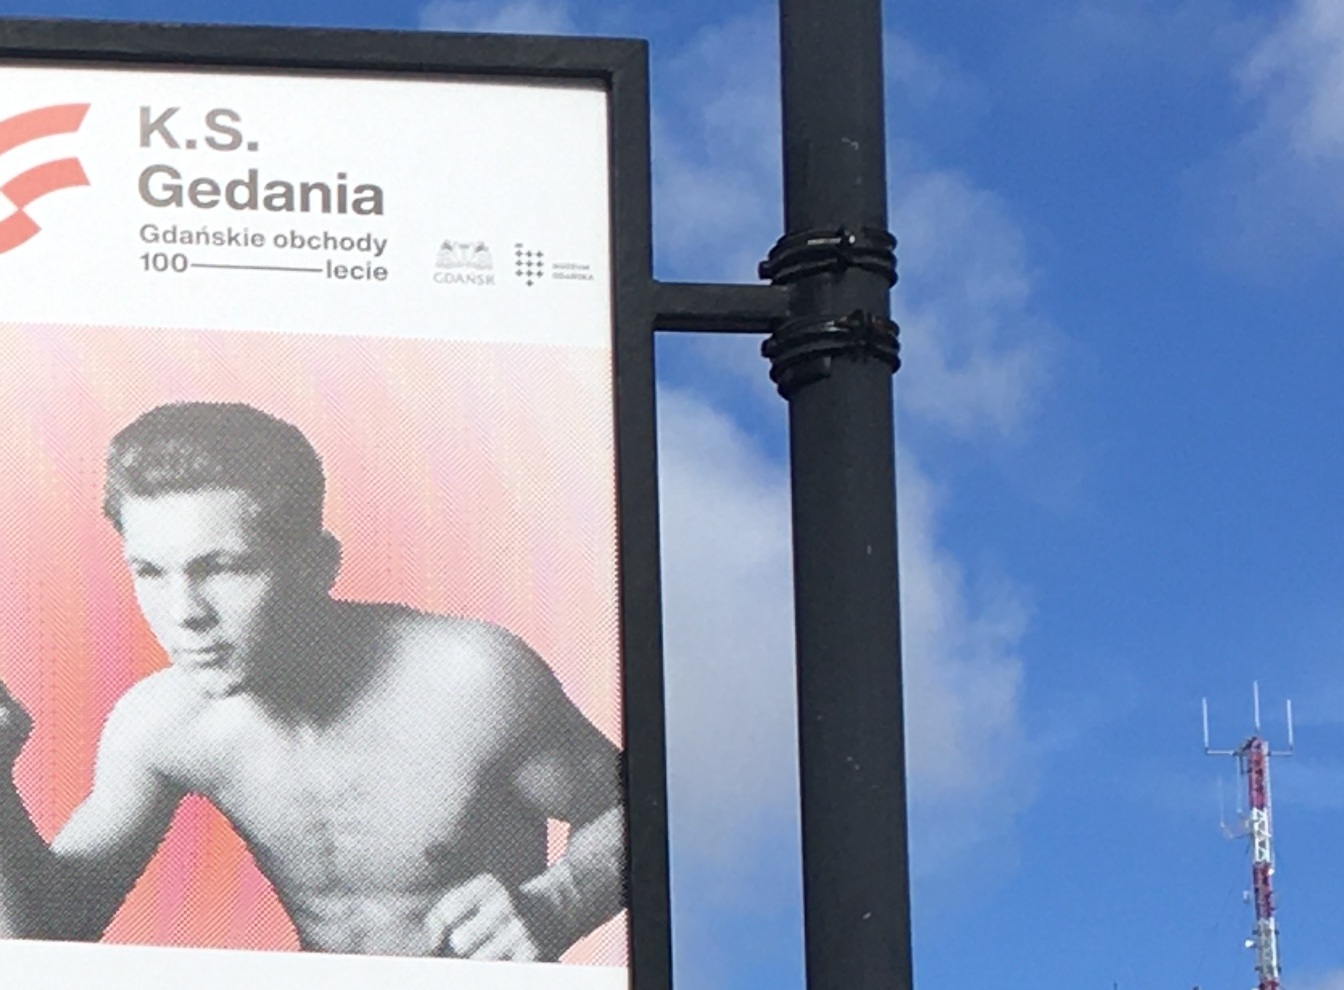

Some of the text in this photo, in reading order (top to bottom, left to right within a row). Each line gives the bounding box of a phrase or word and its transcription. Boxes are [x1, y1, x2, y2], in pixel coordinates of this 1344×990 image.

[140, 107, 259, 152] K.S.
[138, 164, 385, 216] Gedania
[139, 224, 388, 257] Gdańskie obchody
